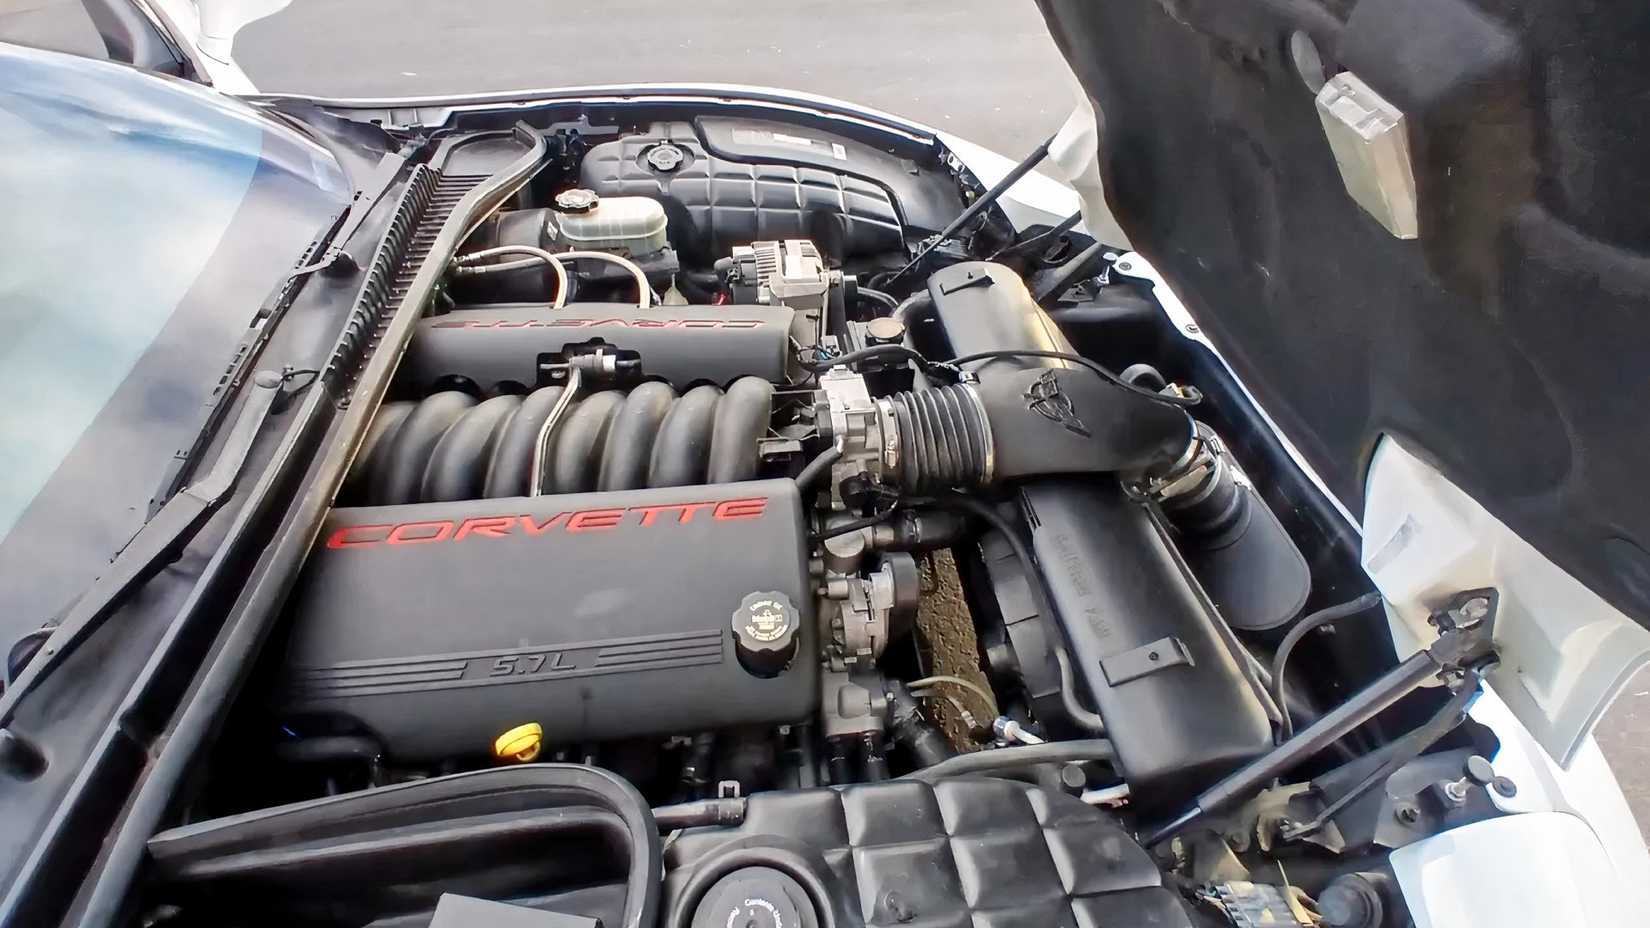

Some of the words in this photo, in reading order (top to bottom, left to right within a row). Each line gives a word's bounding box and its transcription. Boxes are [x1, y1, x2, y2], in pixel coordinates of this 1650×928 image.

[432, 318, 765, 329] CORVETTE
[327, 497, 768, 549] CORVETTE
[489, 653, 577, 677] 5.7L
